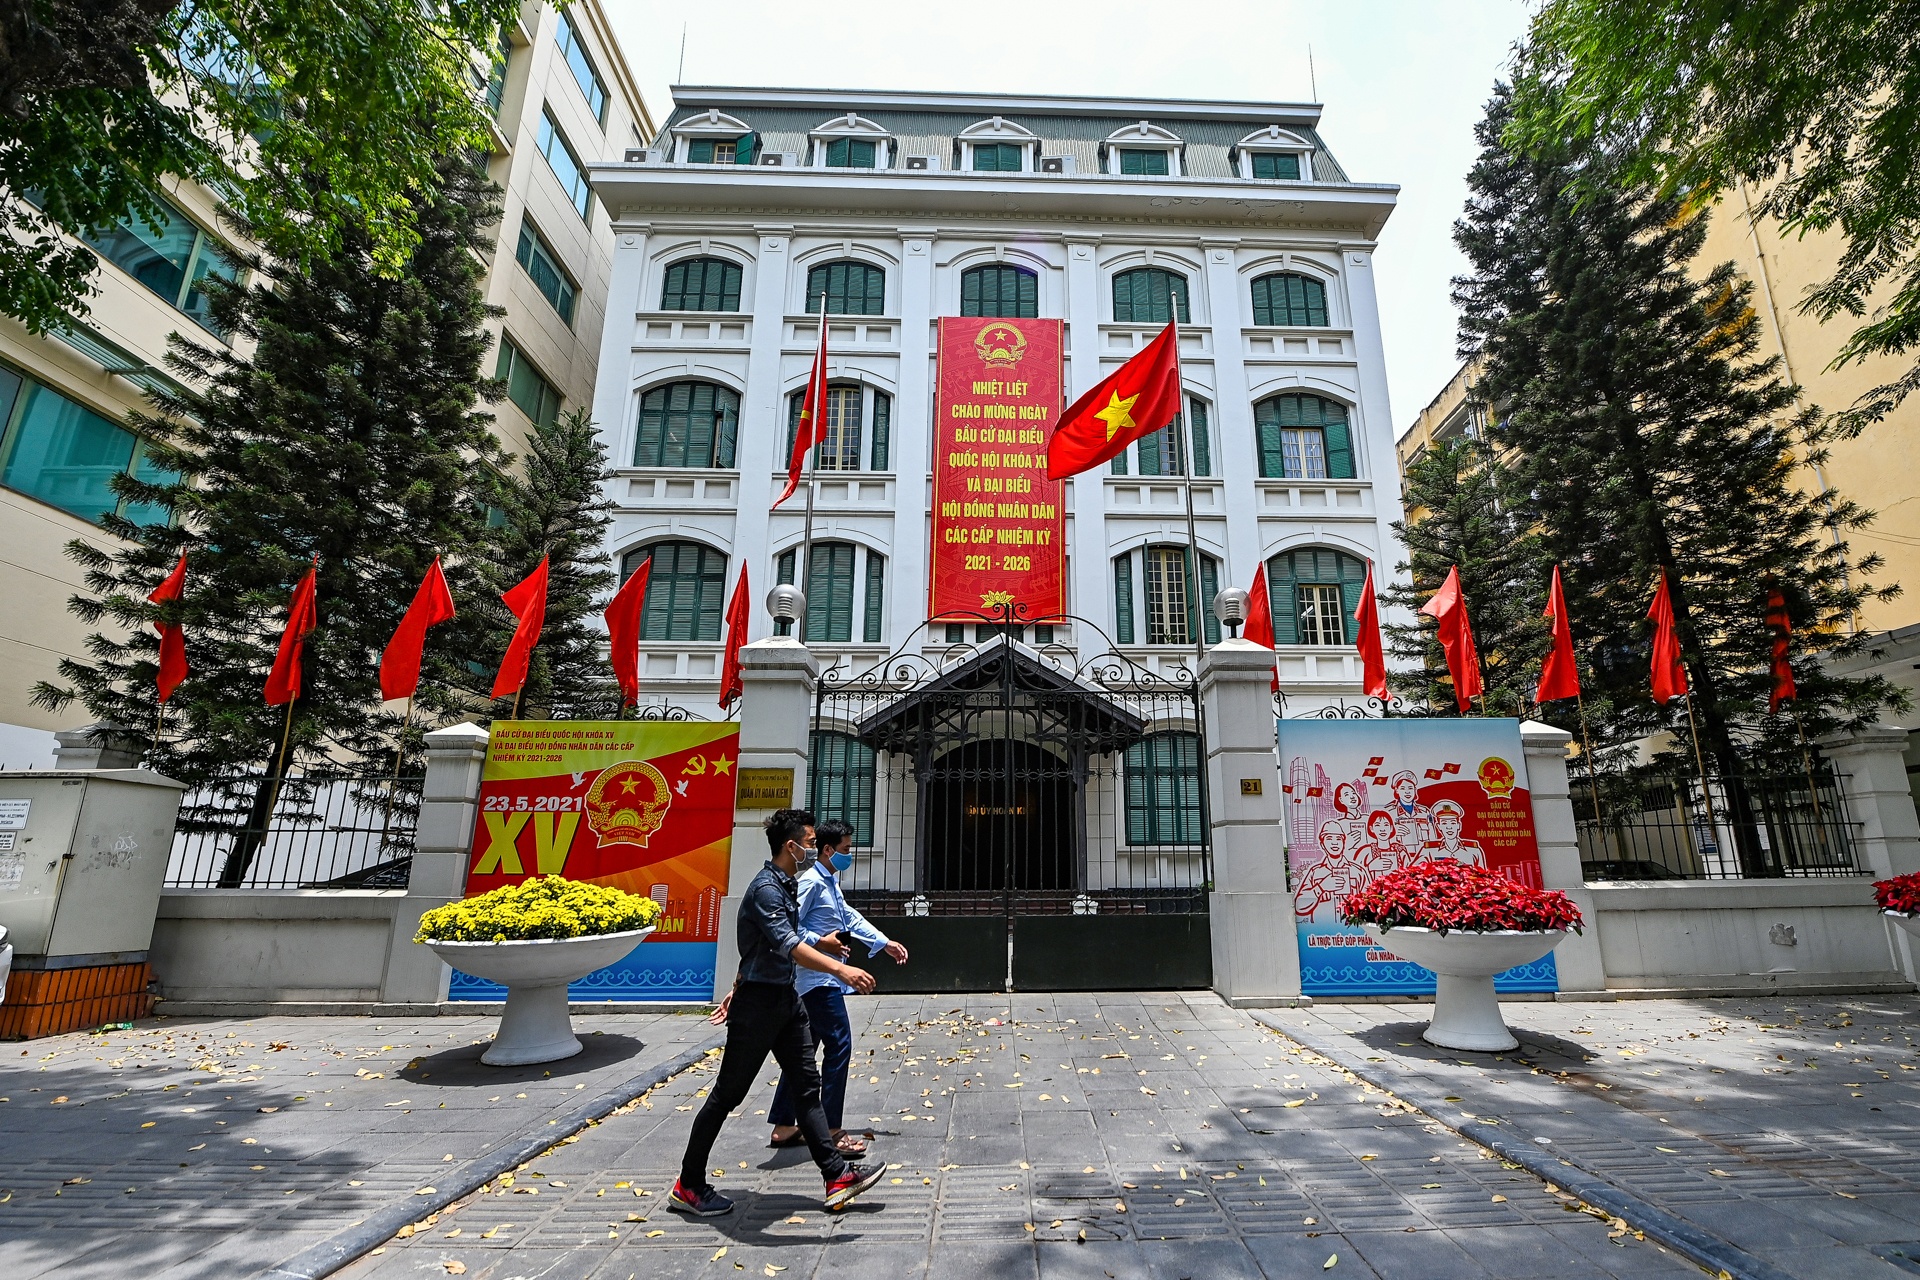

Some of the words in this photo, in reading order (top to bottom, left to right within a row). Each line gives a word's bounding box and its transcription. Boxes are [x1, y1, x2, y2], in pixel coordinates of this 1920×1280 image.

[972, 379, 1003, 398] NHIỆT
[1006, 380, 1028, 398] LIỆT
[952, 402, 980, 418] CHÀO
[984, 402, 1016, 419] MỪNG
[1019, 404, 1048, 420] NGÀY
[955, 424, 977, 442] BẦU
[980, 424, 996, 442] CỬ
[998, 430, 1016, 446] ĐẠI
[1019, 424, 1044, 444] BIỂU
[949, 448, 978, 468] QUỐC
[982, 450, 1000, 470] HỘI
[1003, 451, 1032, 468] KHÓA
[967, 474, 981, 492] VÀ
[984, 478, 1002, 495] ĐẠI
[1006, 473, 1031, 493] BIỂU
[942, 500, 961, 520] HỘI
[964, 498, 994, 517] ĐỒNG
[998, 501, 1028, 518] NHÂN
[1032, 502, 1055, 519] DÂN
[945, 525, 968, 543] CÁC
[971, 524, 994, 543] CẤP
[997, 526, 1033, 547] NHIỆM
[1037, 528, 1051, 545] KỲ
[965, 555, 991, 570] 2021
[1003, 556, 1030, 571] 2026
[522, 731, 534, 740] ĐẠI
[552, 729, 571, 738] QUỐC
[572, 730, 584, 740] HỘI
[585, 730, 603, 738] KHÓA
[494, 741, 503, 750] VÀ
[505, 743, 516, 752] ĐẠI
[535, 742, 547, 752] HỘI
[569, 742, 588, 750] NHÂN
[589, 742, 604, 750] DÂN
[605, 742, 619, 750] CÁC
[620, 741, 635, 750] CẤP
[492, 754, 515, 763] NHIỆM
[1244, 782, 1259, 791] 21
[484, 796, 582, 811] 23.5.2021
[472, 812, 581, 874] XV
[653, 915, 684, 932] DÂN
